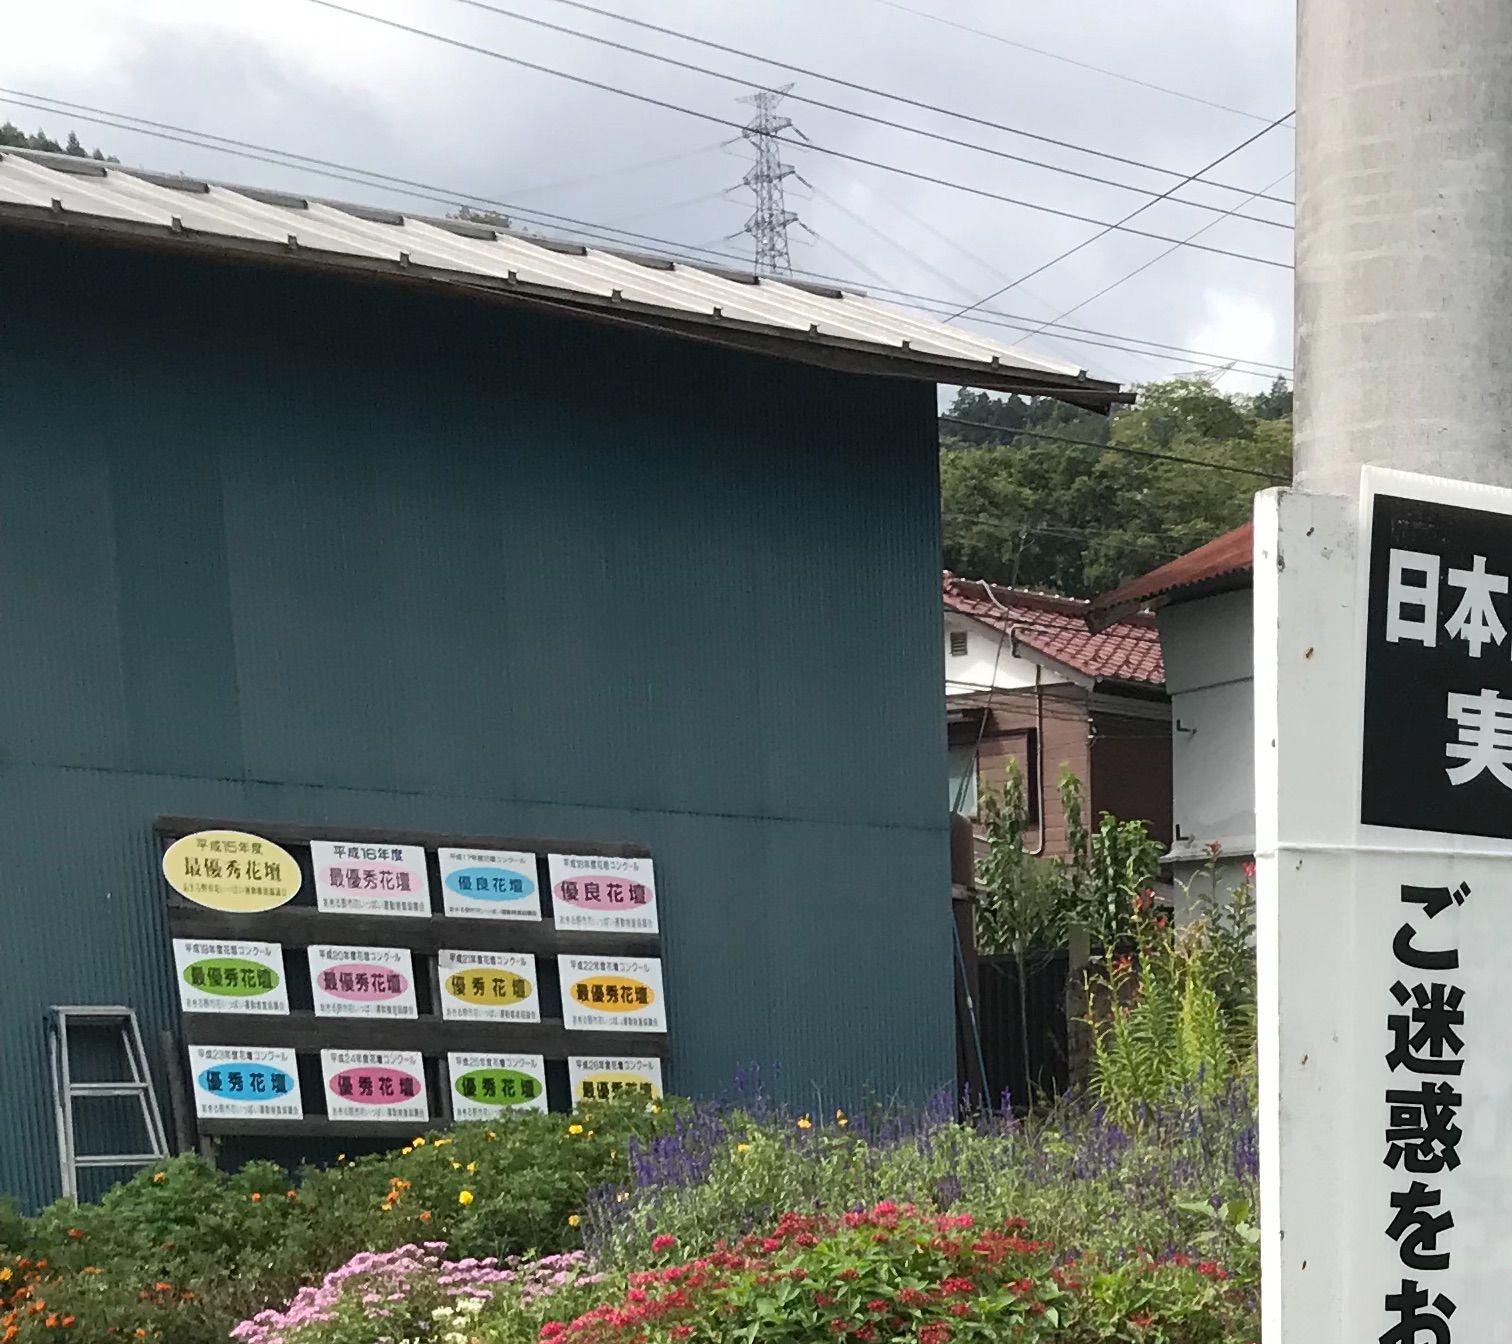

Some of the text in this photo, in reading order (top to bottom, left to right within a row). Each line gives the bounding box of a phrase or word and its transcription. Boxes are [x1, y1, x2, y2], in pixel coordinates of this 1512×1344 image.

[184, 855, 283, 882] 最優秀花壇
[330, 867, 412, 891] 最優秀花壇
[458, 875, 524, 893] 優良花壇
[560, 880, 647, 905] 優良花壇
[191, 966, 274, 989] 最優秀花壇
[324, 971, 402, 994] 最優秀花壇
[451, 974, 528, 998] 優秀花壇
[577, 983, 649, 1005] 最優秀花壇
[206, 1070, 288, 1094] 優秀花壇
[338, 1074, 416, 1097] 優秀花壇
[461, 1076, 536, 1098] 優秀花壇
